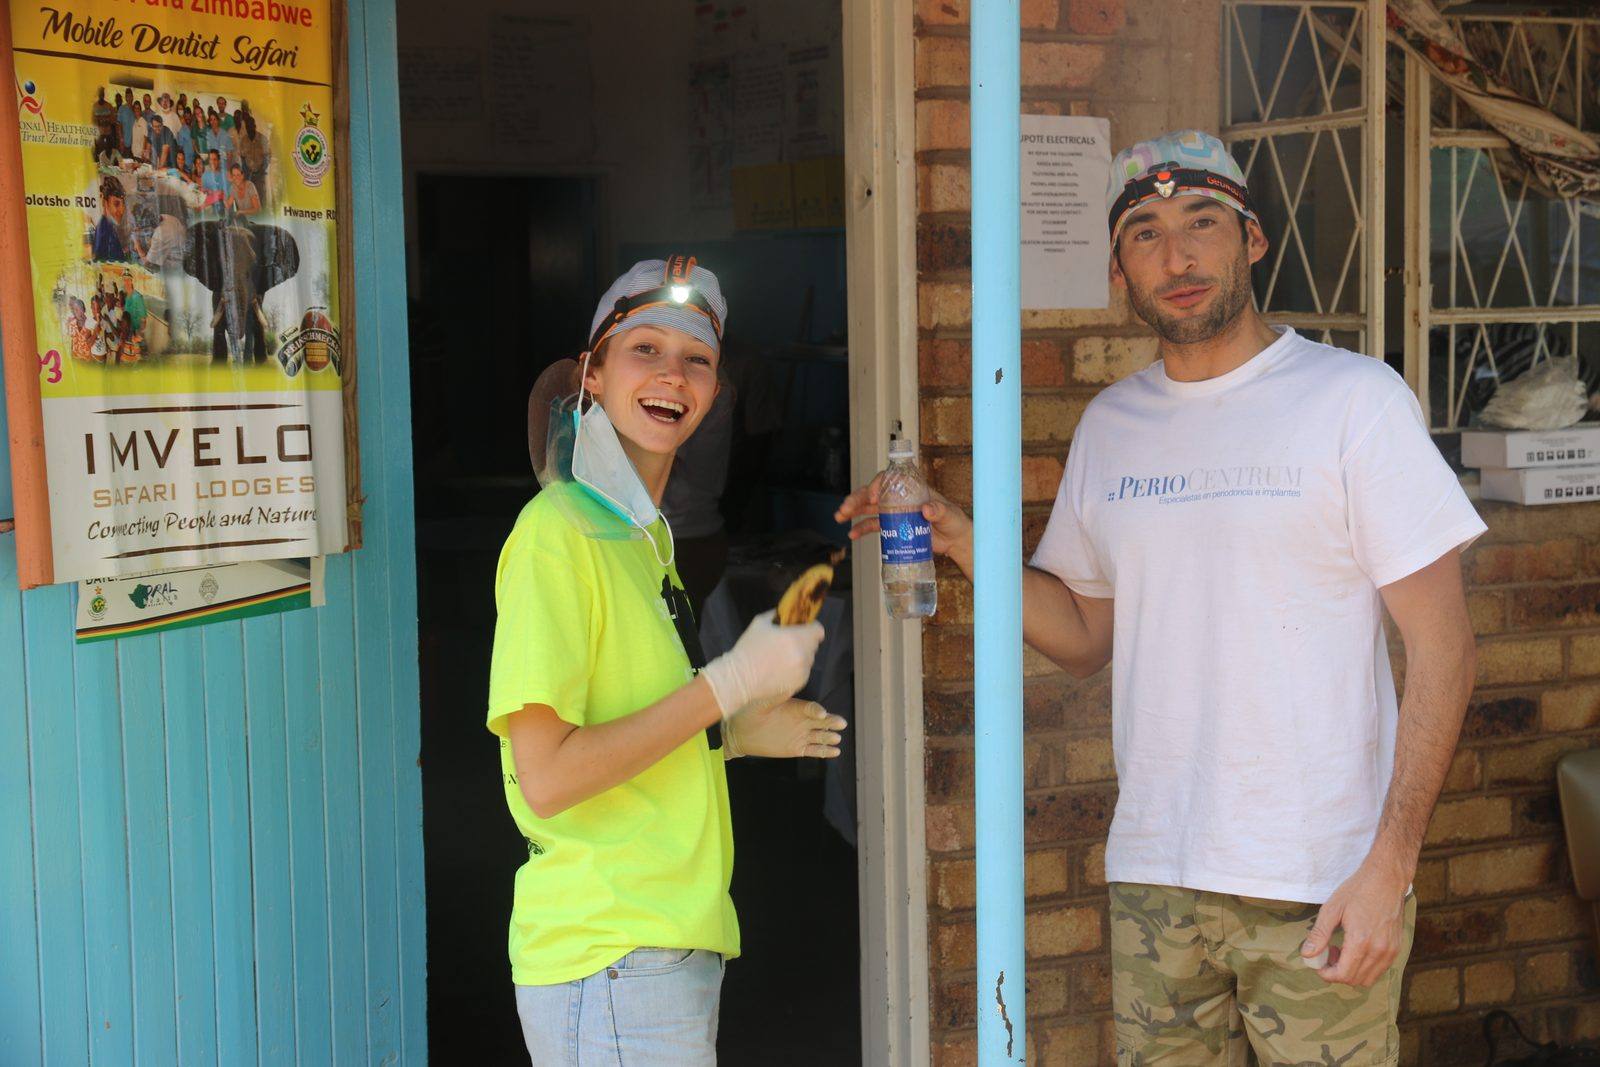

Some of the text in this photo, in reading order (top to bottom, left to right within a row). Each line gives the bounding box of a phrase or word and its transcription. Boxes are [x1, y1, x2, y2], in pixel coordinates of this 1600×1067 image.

[40, 7, 299, 71] Mobile Dentist Safari
[1046, 135, 1096, 145] ELECTRICALS
[25, 194, 97, 208] olotsho RDC
[283, 206, 323, 221] Hwange
[85, 424, 313, 475] IMVELO
[93, 476, 315, 508] SAFARI LODGES
[1262, 487, 1301, 499] implantes
[164, 510, 216, 533] People
[219, 506, 253, 527] and
